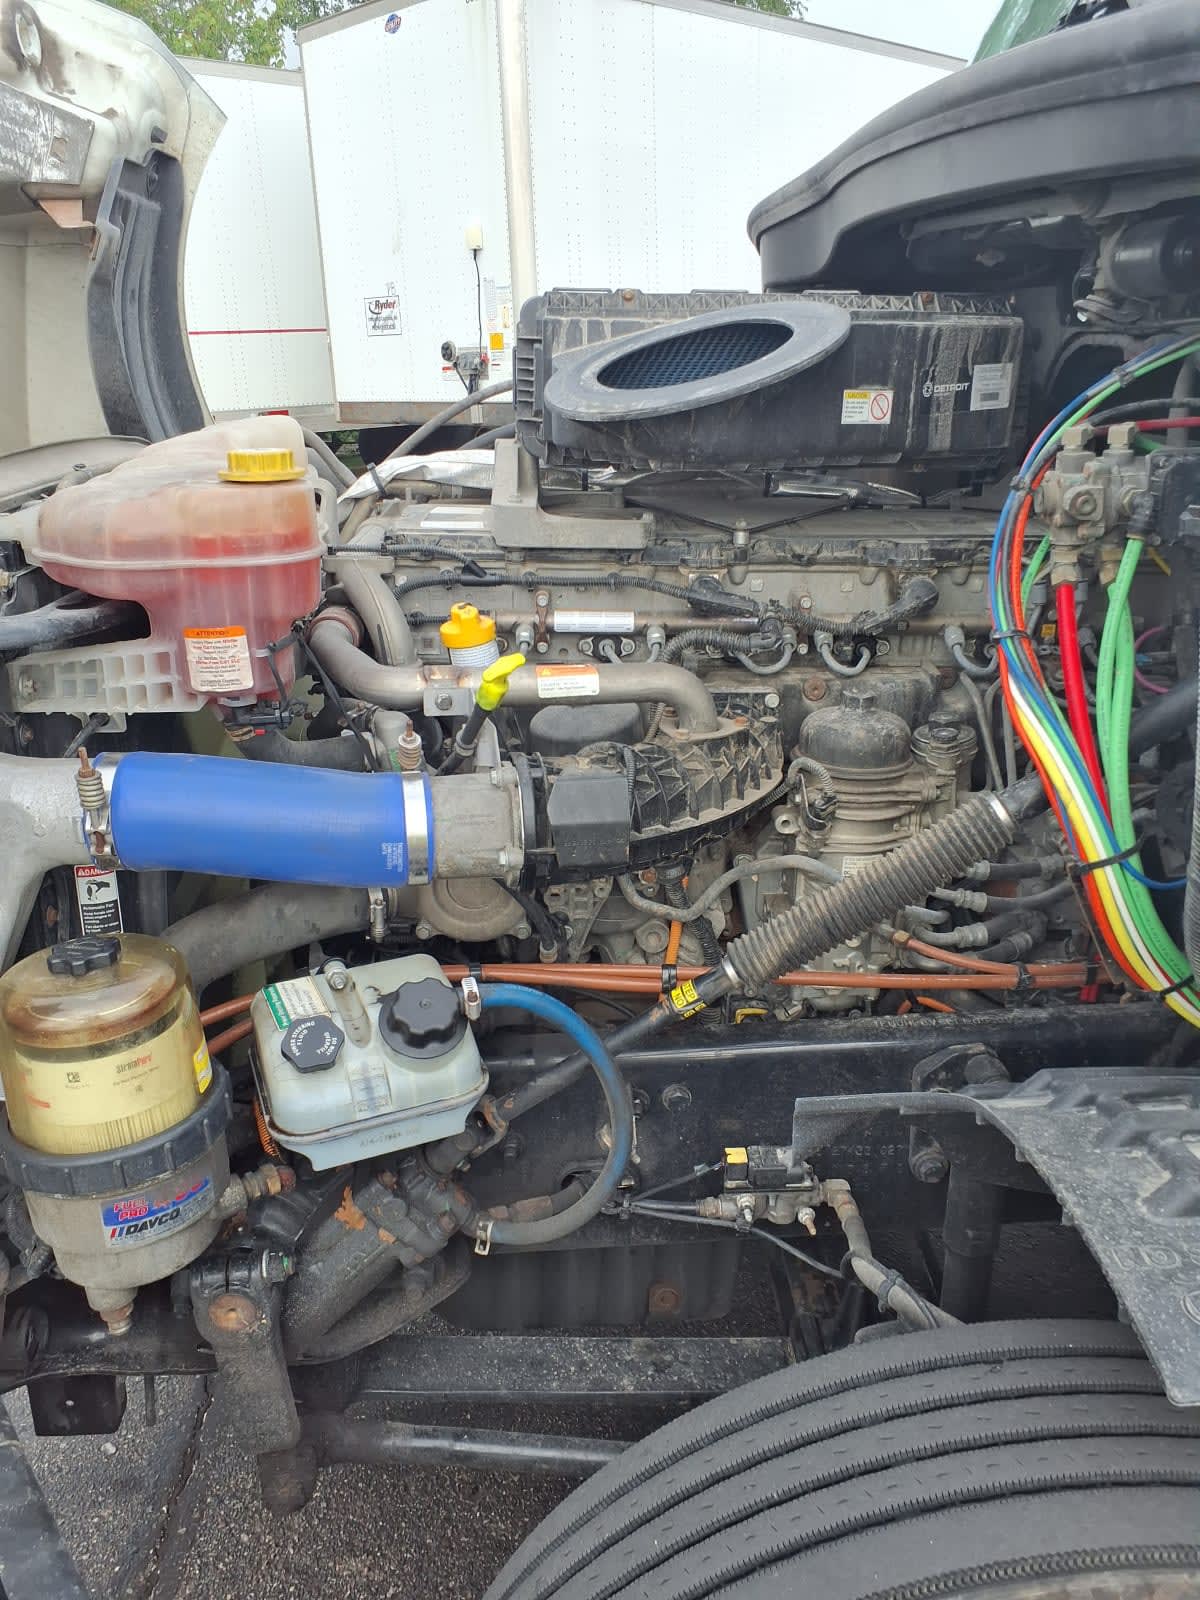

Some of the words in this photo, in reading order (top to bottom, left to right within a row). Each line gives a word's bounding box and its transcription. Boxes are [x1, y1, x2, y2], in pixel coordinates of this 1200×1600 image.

[374, 299, 397, 312] Ryder
[933, 382, 971, 394] DETROIT
[292, 1021, 315, 1038] STEERING
[113, 1198, 146, 1213] FUEL
[118, 1205, 149, 1221] PRO
[125, 1207, 181, 1236] DAVCO
